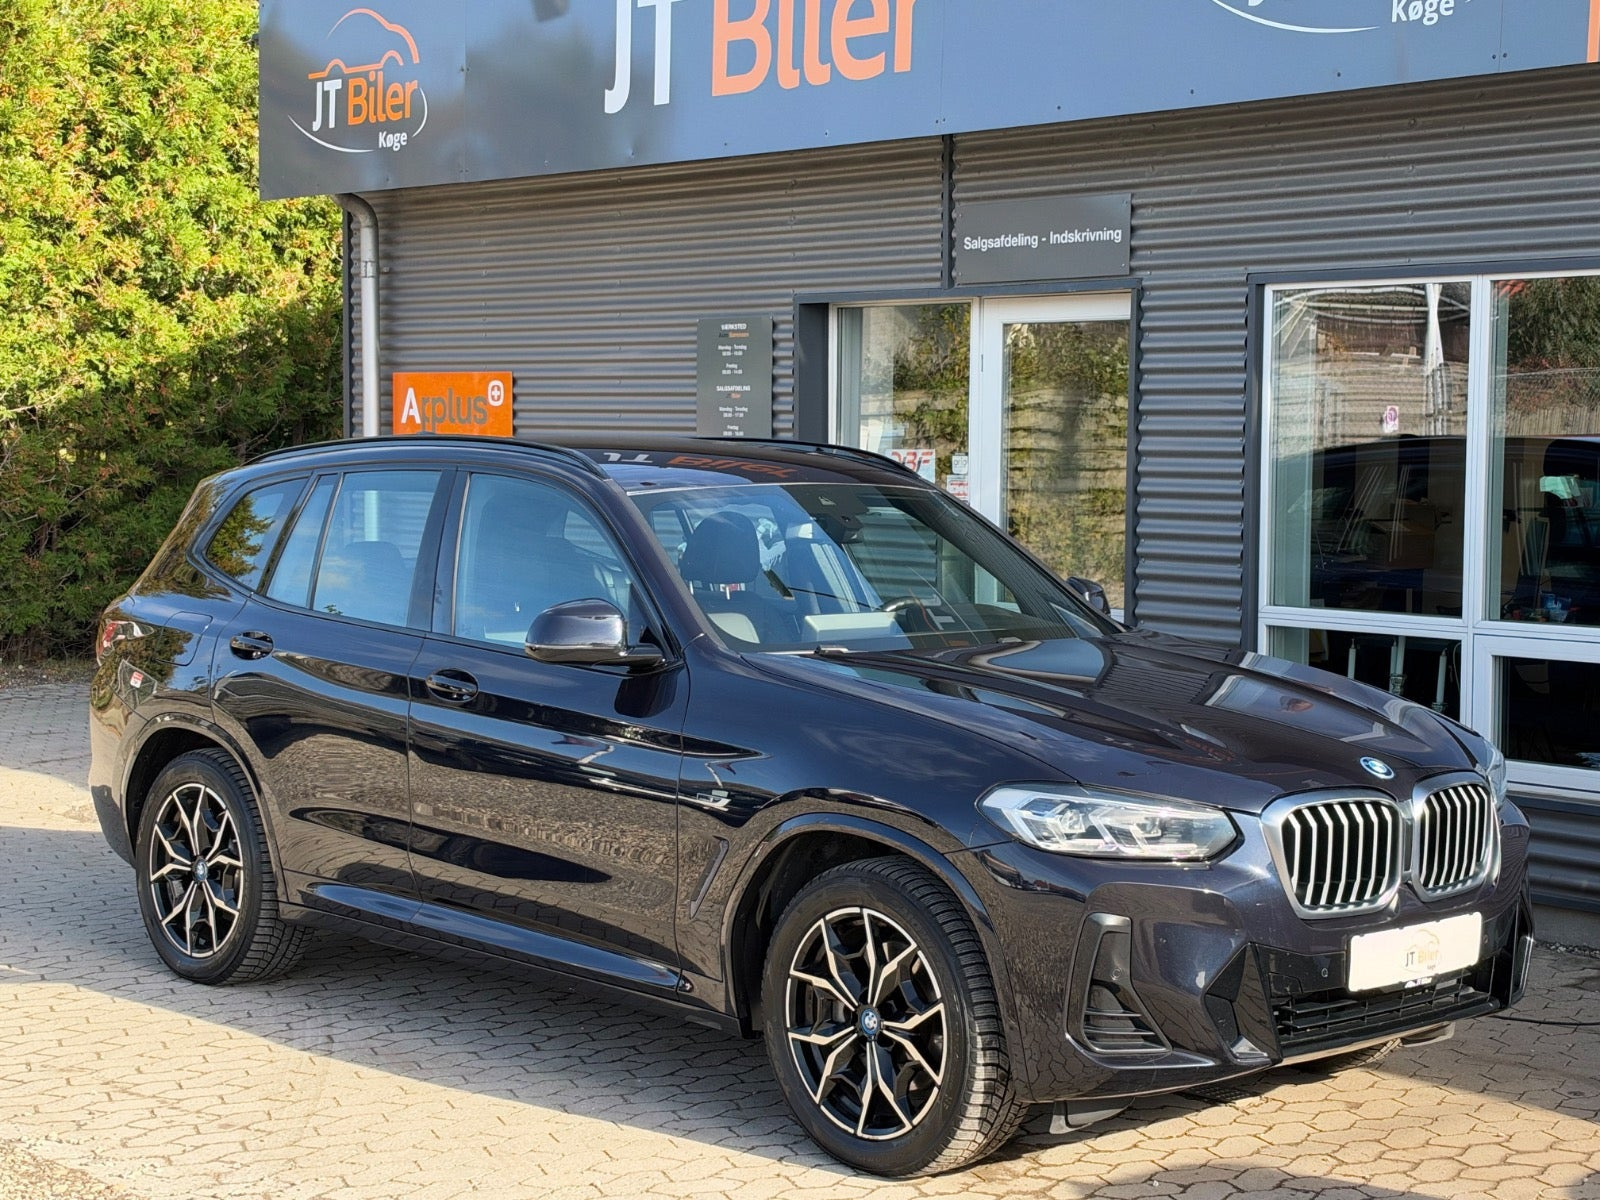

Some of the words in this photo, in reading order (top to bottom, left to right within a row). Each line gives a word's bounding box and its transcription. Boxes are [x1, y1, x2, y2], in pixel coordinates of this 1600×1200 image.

[312, 78, 342, 132] JT
[347, 71, 418, 126] Biler
[378, 131, 408, 151] Køge
[963, 233, 1039, 252] Salgsafdeling
[1050, 227, 1122, 244] Indskrivning
